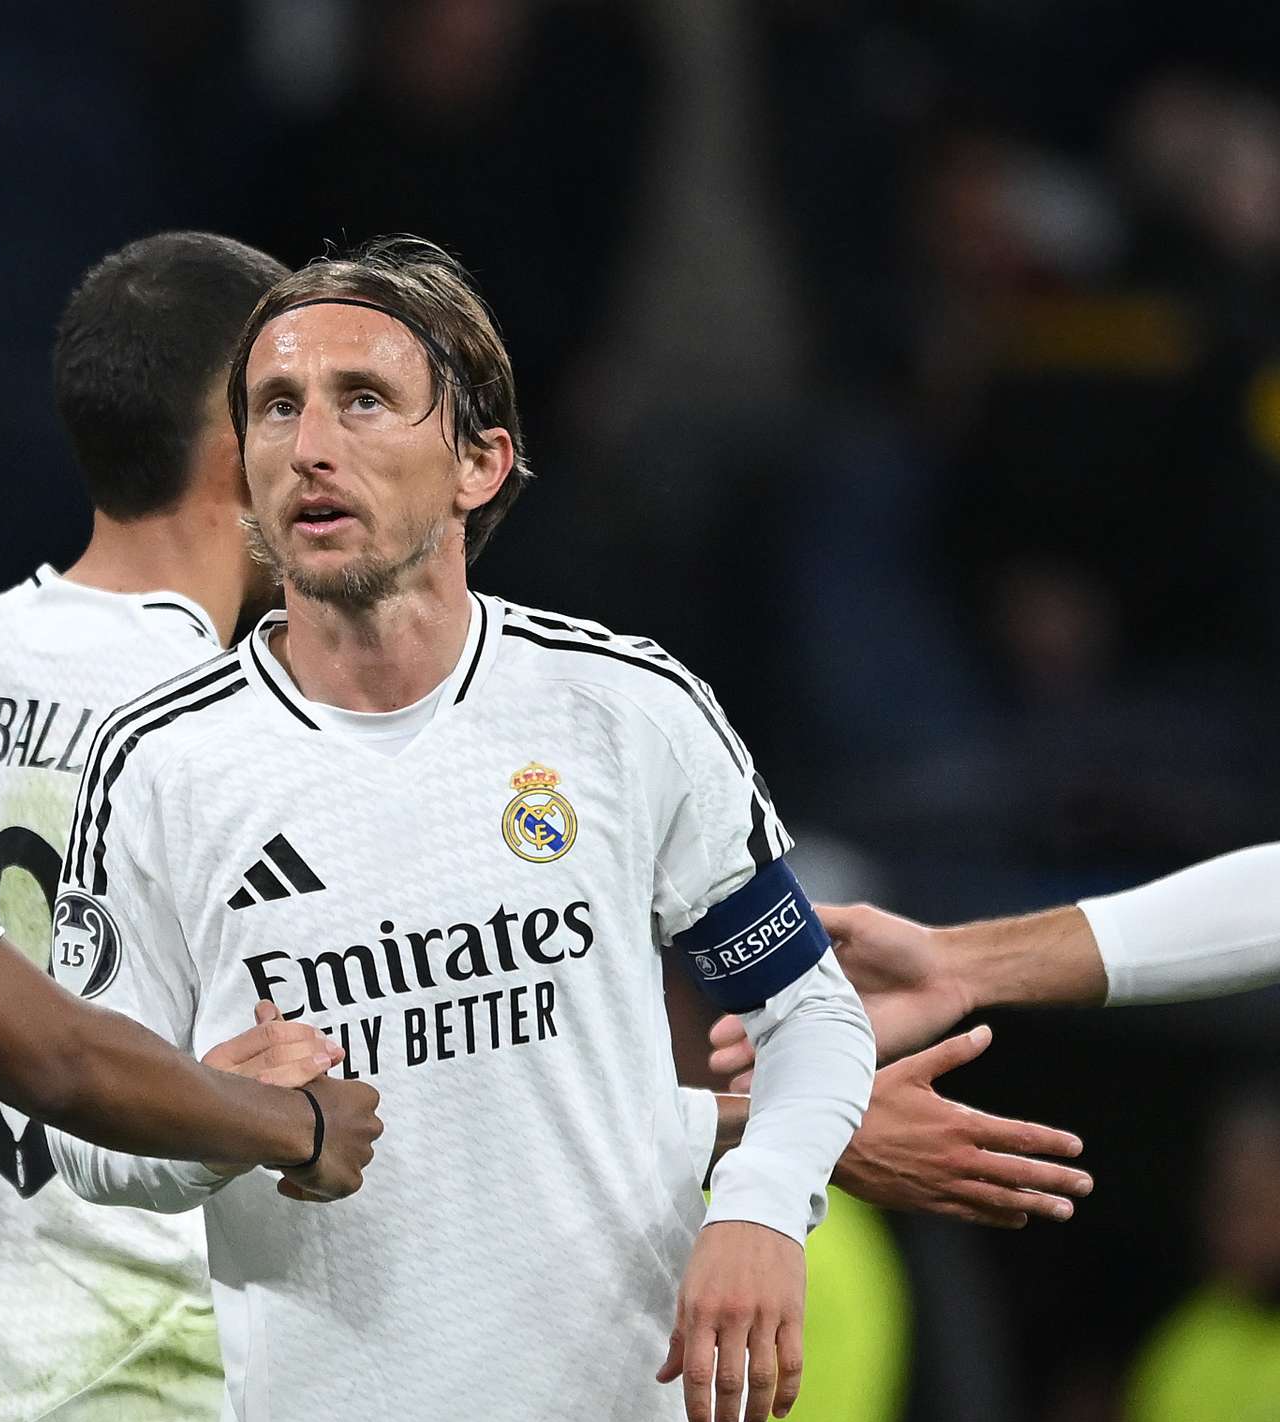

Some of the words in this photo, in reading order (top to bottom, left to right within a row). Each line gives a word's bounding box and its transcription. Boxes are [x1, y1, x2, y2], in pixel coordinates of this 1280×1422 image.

[60, 942, 85, 967] 15
[242, 901, 594, 1021] Emirates
[719, 899, 801, 968] RESPECT
[324, 1015, 382, 1080] LY
[404, 980, 558, 1067] BETTER
